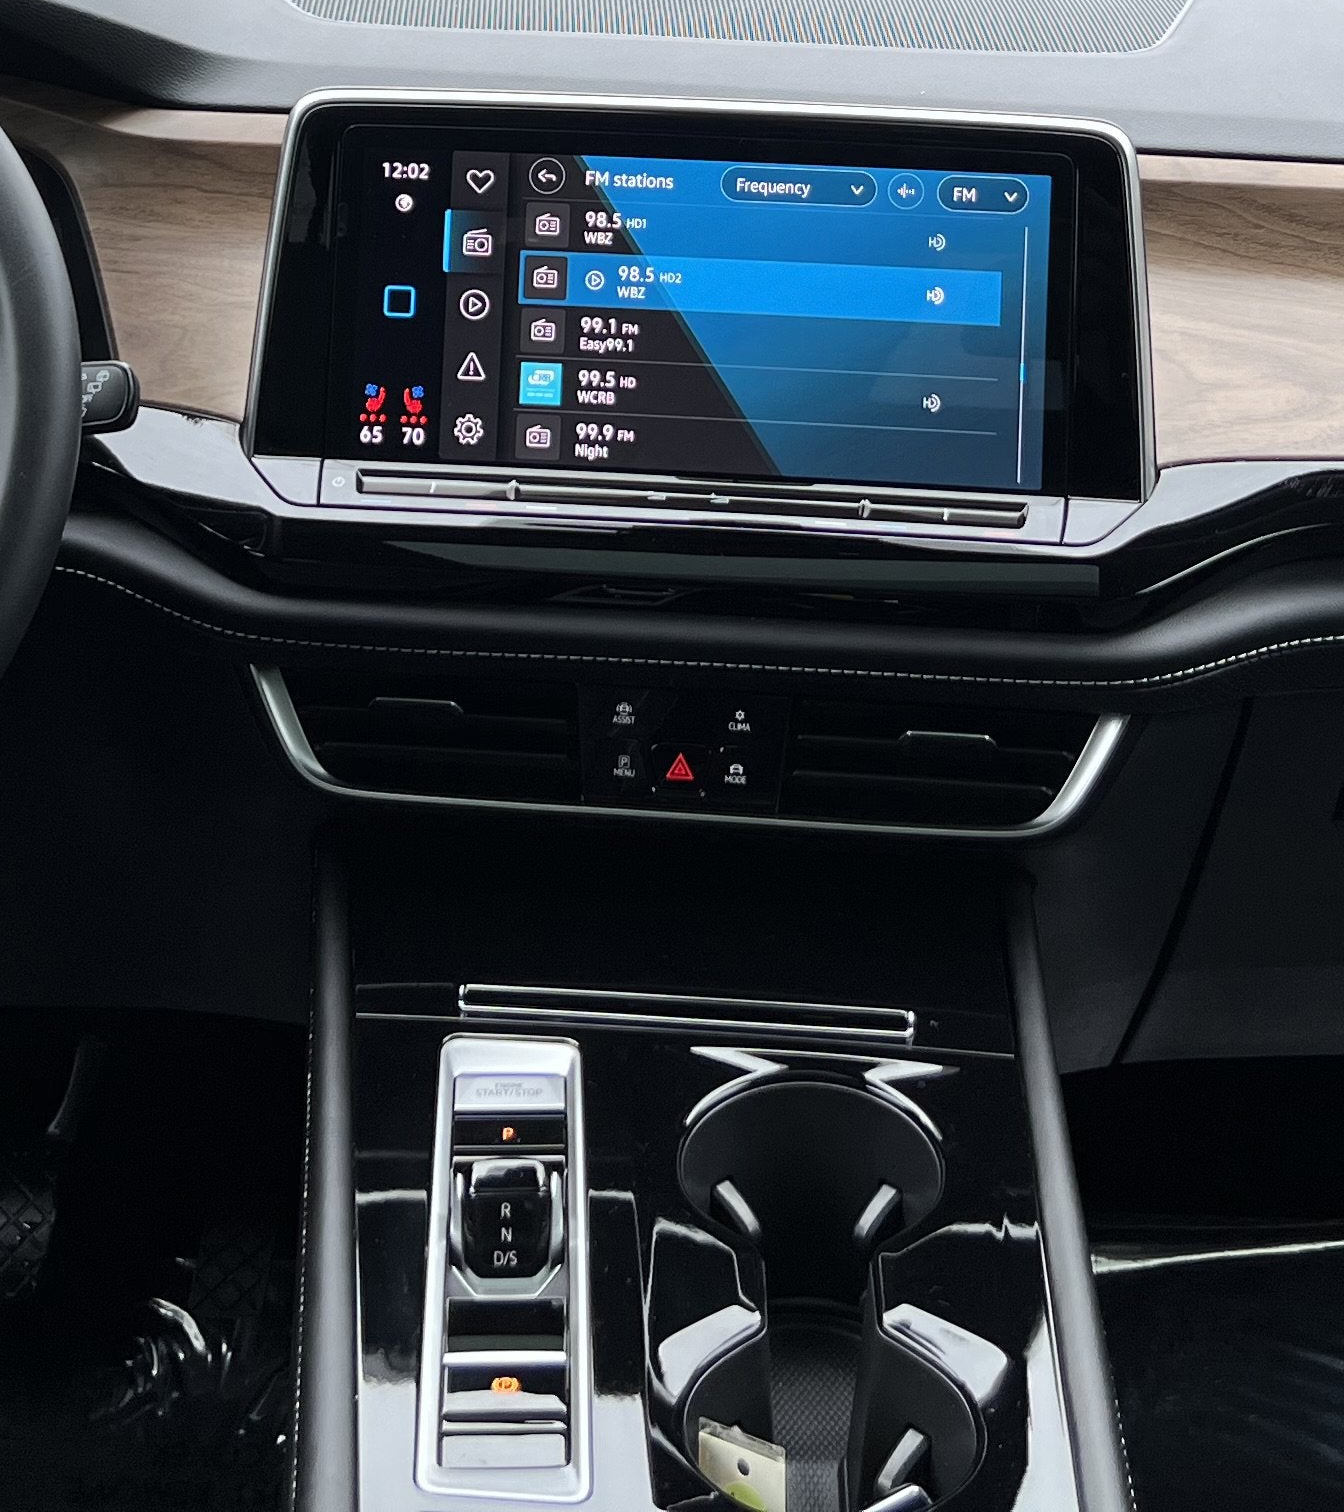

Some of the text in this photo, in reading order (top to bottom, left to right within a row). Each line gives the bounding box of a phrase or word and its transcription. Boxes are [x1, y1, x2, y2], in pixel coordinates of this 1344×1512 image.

[382, 161, 430, 180] 12:02
[584, 170, 674, 190] FM stations
[736, 178, 811, 197] Frequency
[952, 187, 977, 203] FM
[584, 211, 647, 229] 98.5 HD1
[583, 230, 614, 246] WBZ
[617, 266, 682, 285] 98.5 HD2
[616, 285, 646, 300] WBZ
[580, 316, 639, 336] 99.1 FM
[579, 337, 634, 354] Easy99.1
[578, 369, 636, 389] 99.5 HD
[576, 390, 616, 405] WCRB
[360, 426, 384, 444] 65
[401, 427, 425, 445] 70
[575, 423, 635, 442] 99.9 FM
[575, 443, 609, 460] Night
[613, 715, 636, 725] ASSIST
[728, 721, 751, 731] CLIMA
[613, 768, 636, 778] MENU
[724, 775, 747, 785] MODE
[475, 1087, 544, 1098] START/STOP
[502, 1126, 515, 1141] P
[500, 1202, 512, 1218] R
[501, 1228, 512, 1243] N
[493, 1249, 519, 1267] D/S
